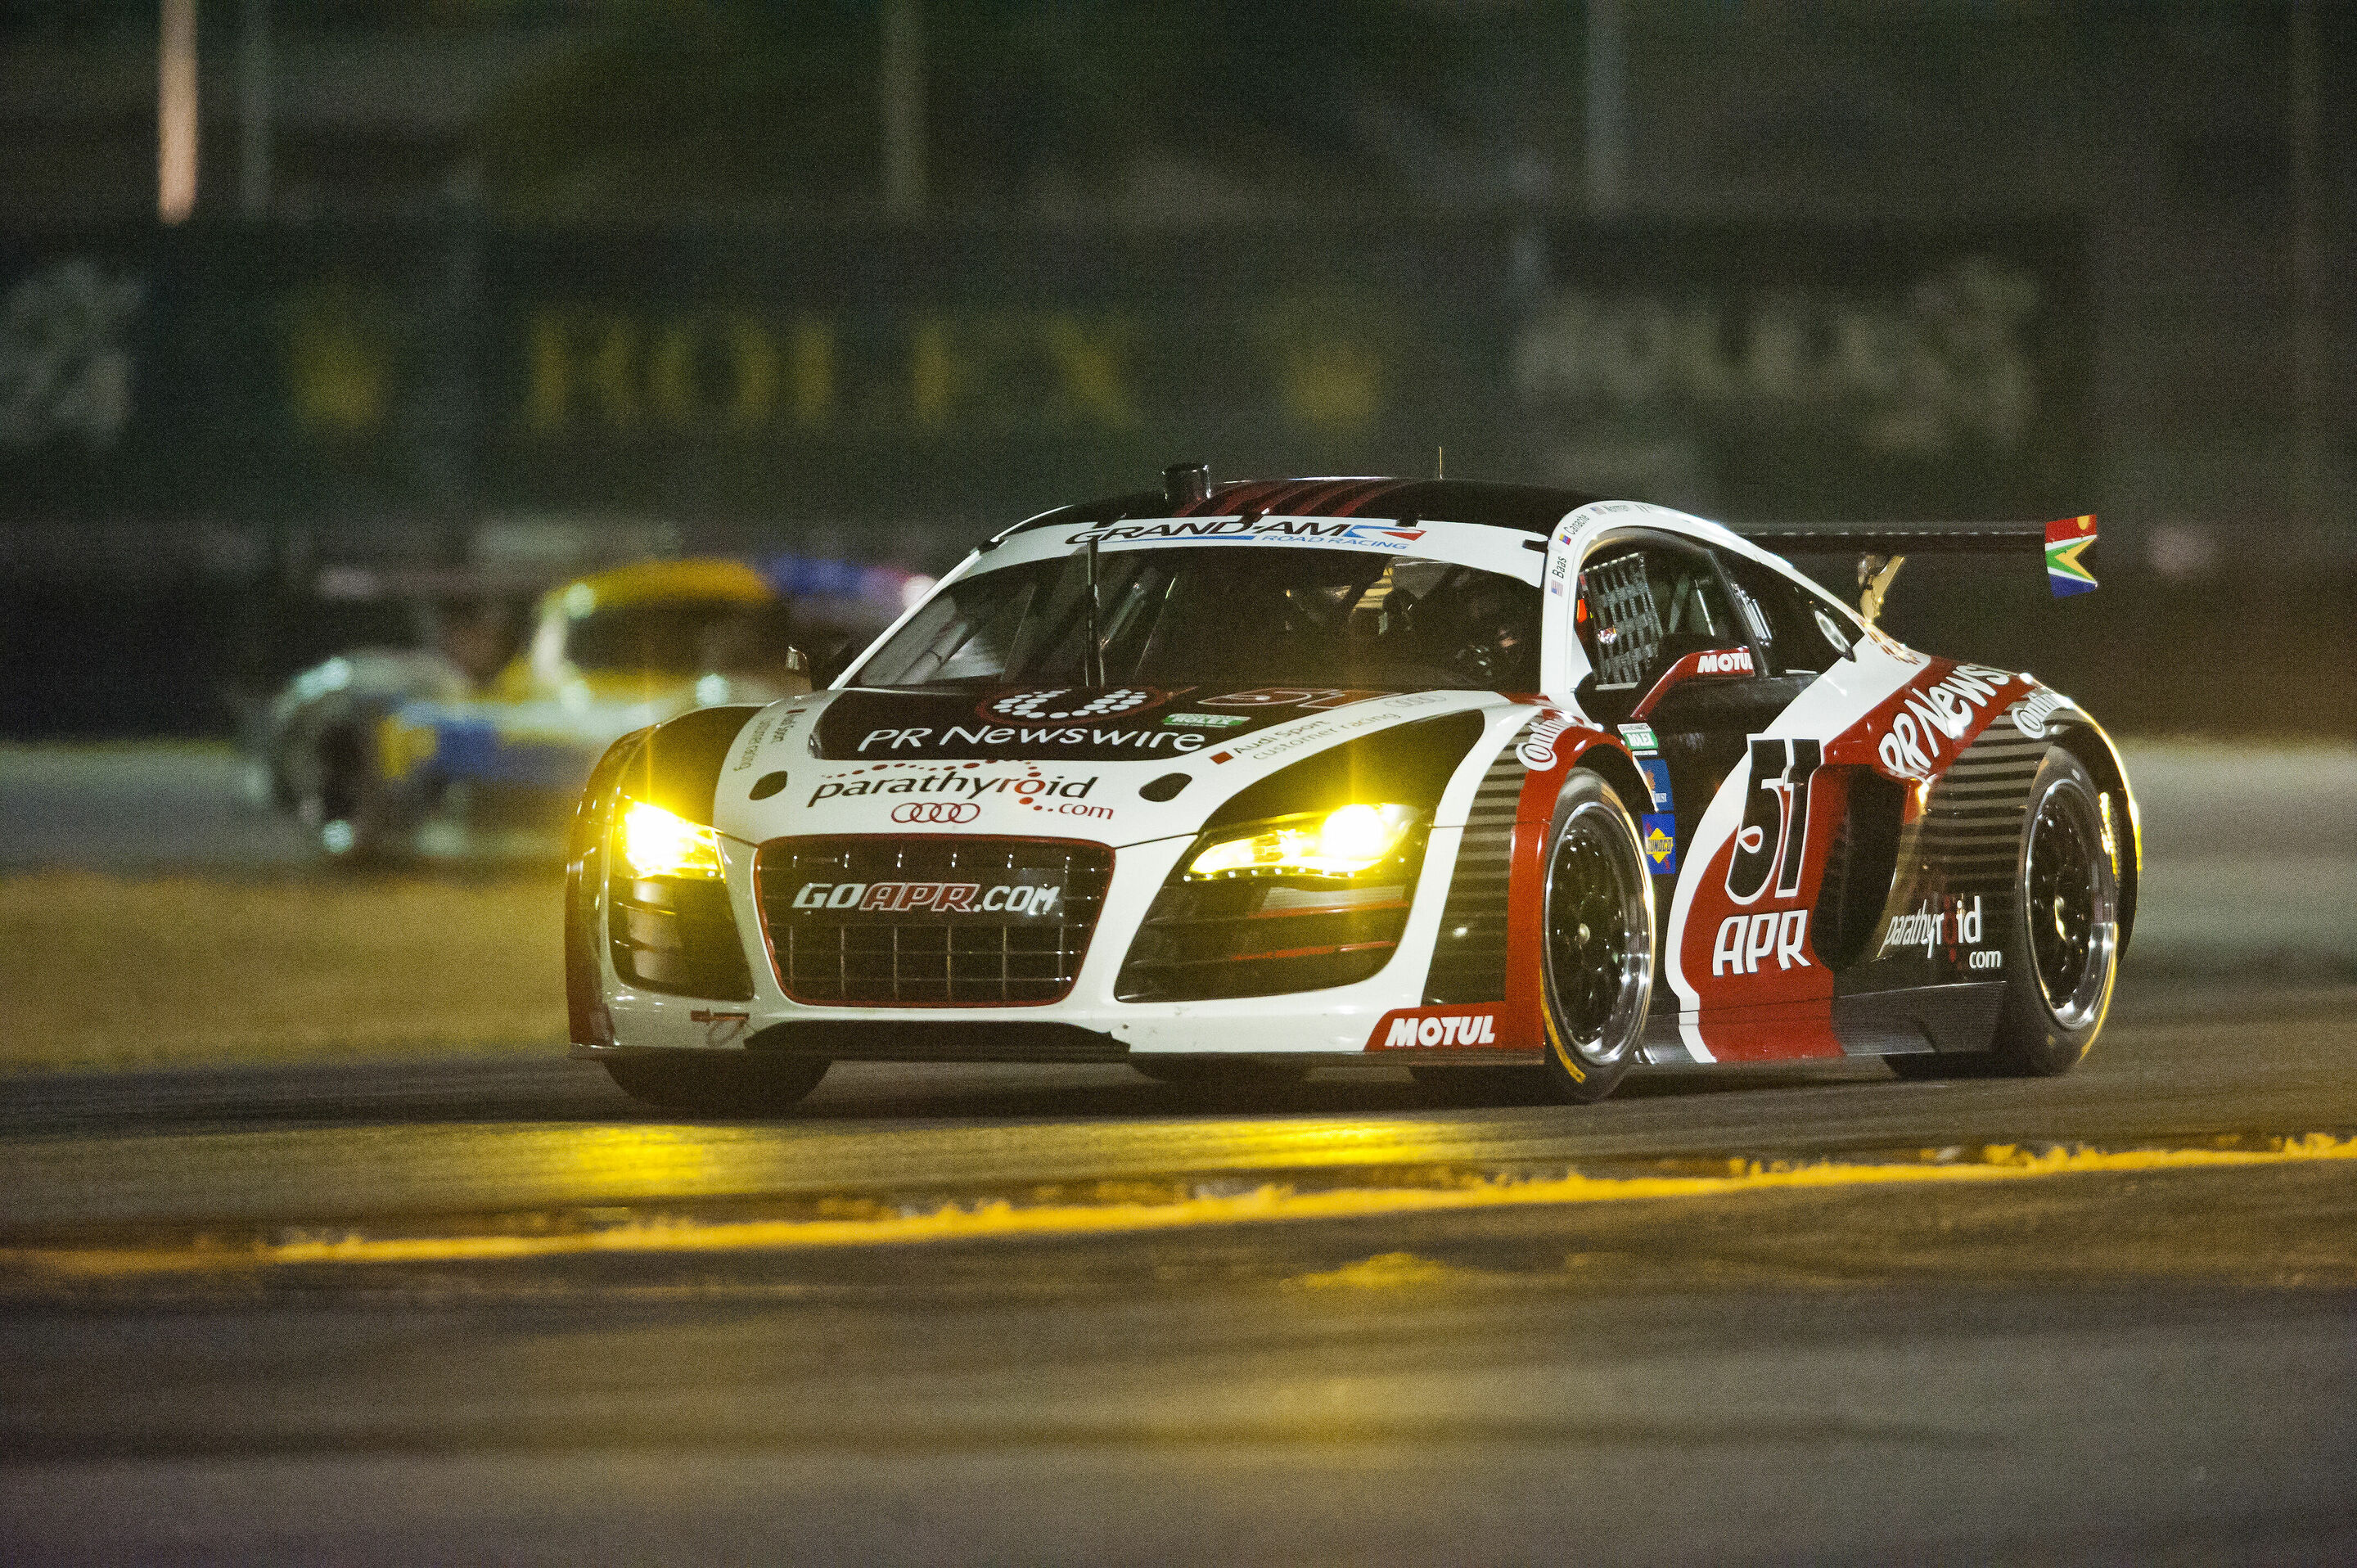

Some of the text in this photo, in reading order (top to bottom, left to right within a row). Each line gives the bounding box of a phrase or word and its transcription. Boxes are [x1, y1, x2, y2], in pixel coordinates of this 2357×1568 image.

[1065, 520, 1351, 544] GRAND-AM
[1262, 534, 1409, 551] ROAD RACING
[1552, 556, 1568, 579] Baas
[857, 725, 1206, 751] PR Newswire
[1233, 719, 1330, 755] Audi Sport
[806, 771, 1099, 808] parathyroid
[1724, 733, 1824, 904] 51
[1712, 909, 1811, 977] APR
[1876, 895, 1981, 959] parathyroid
[1385, 1015, 1495, 1047] MOTUL
